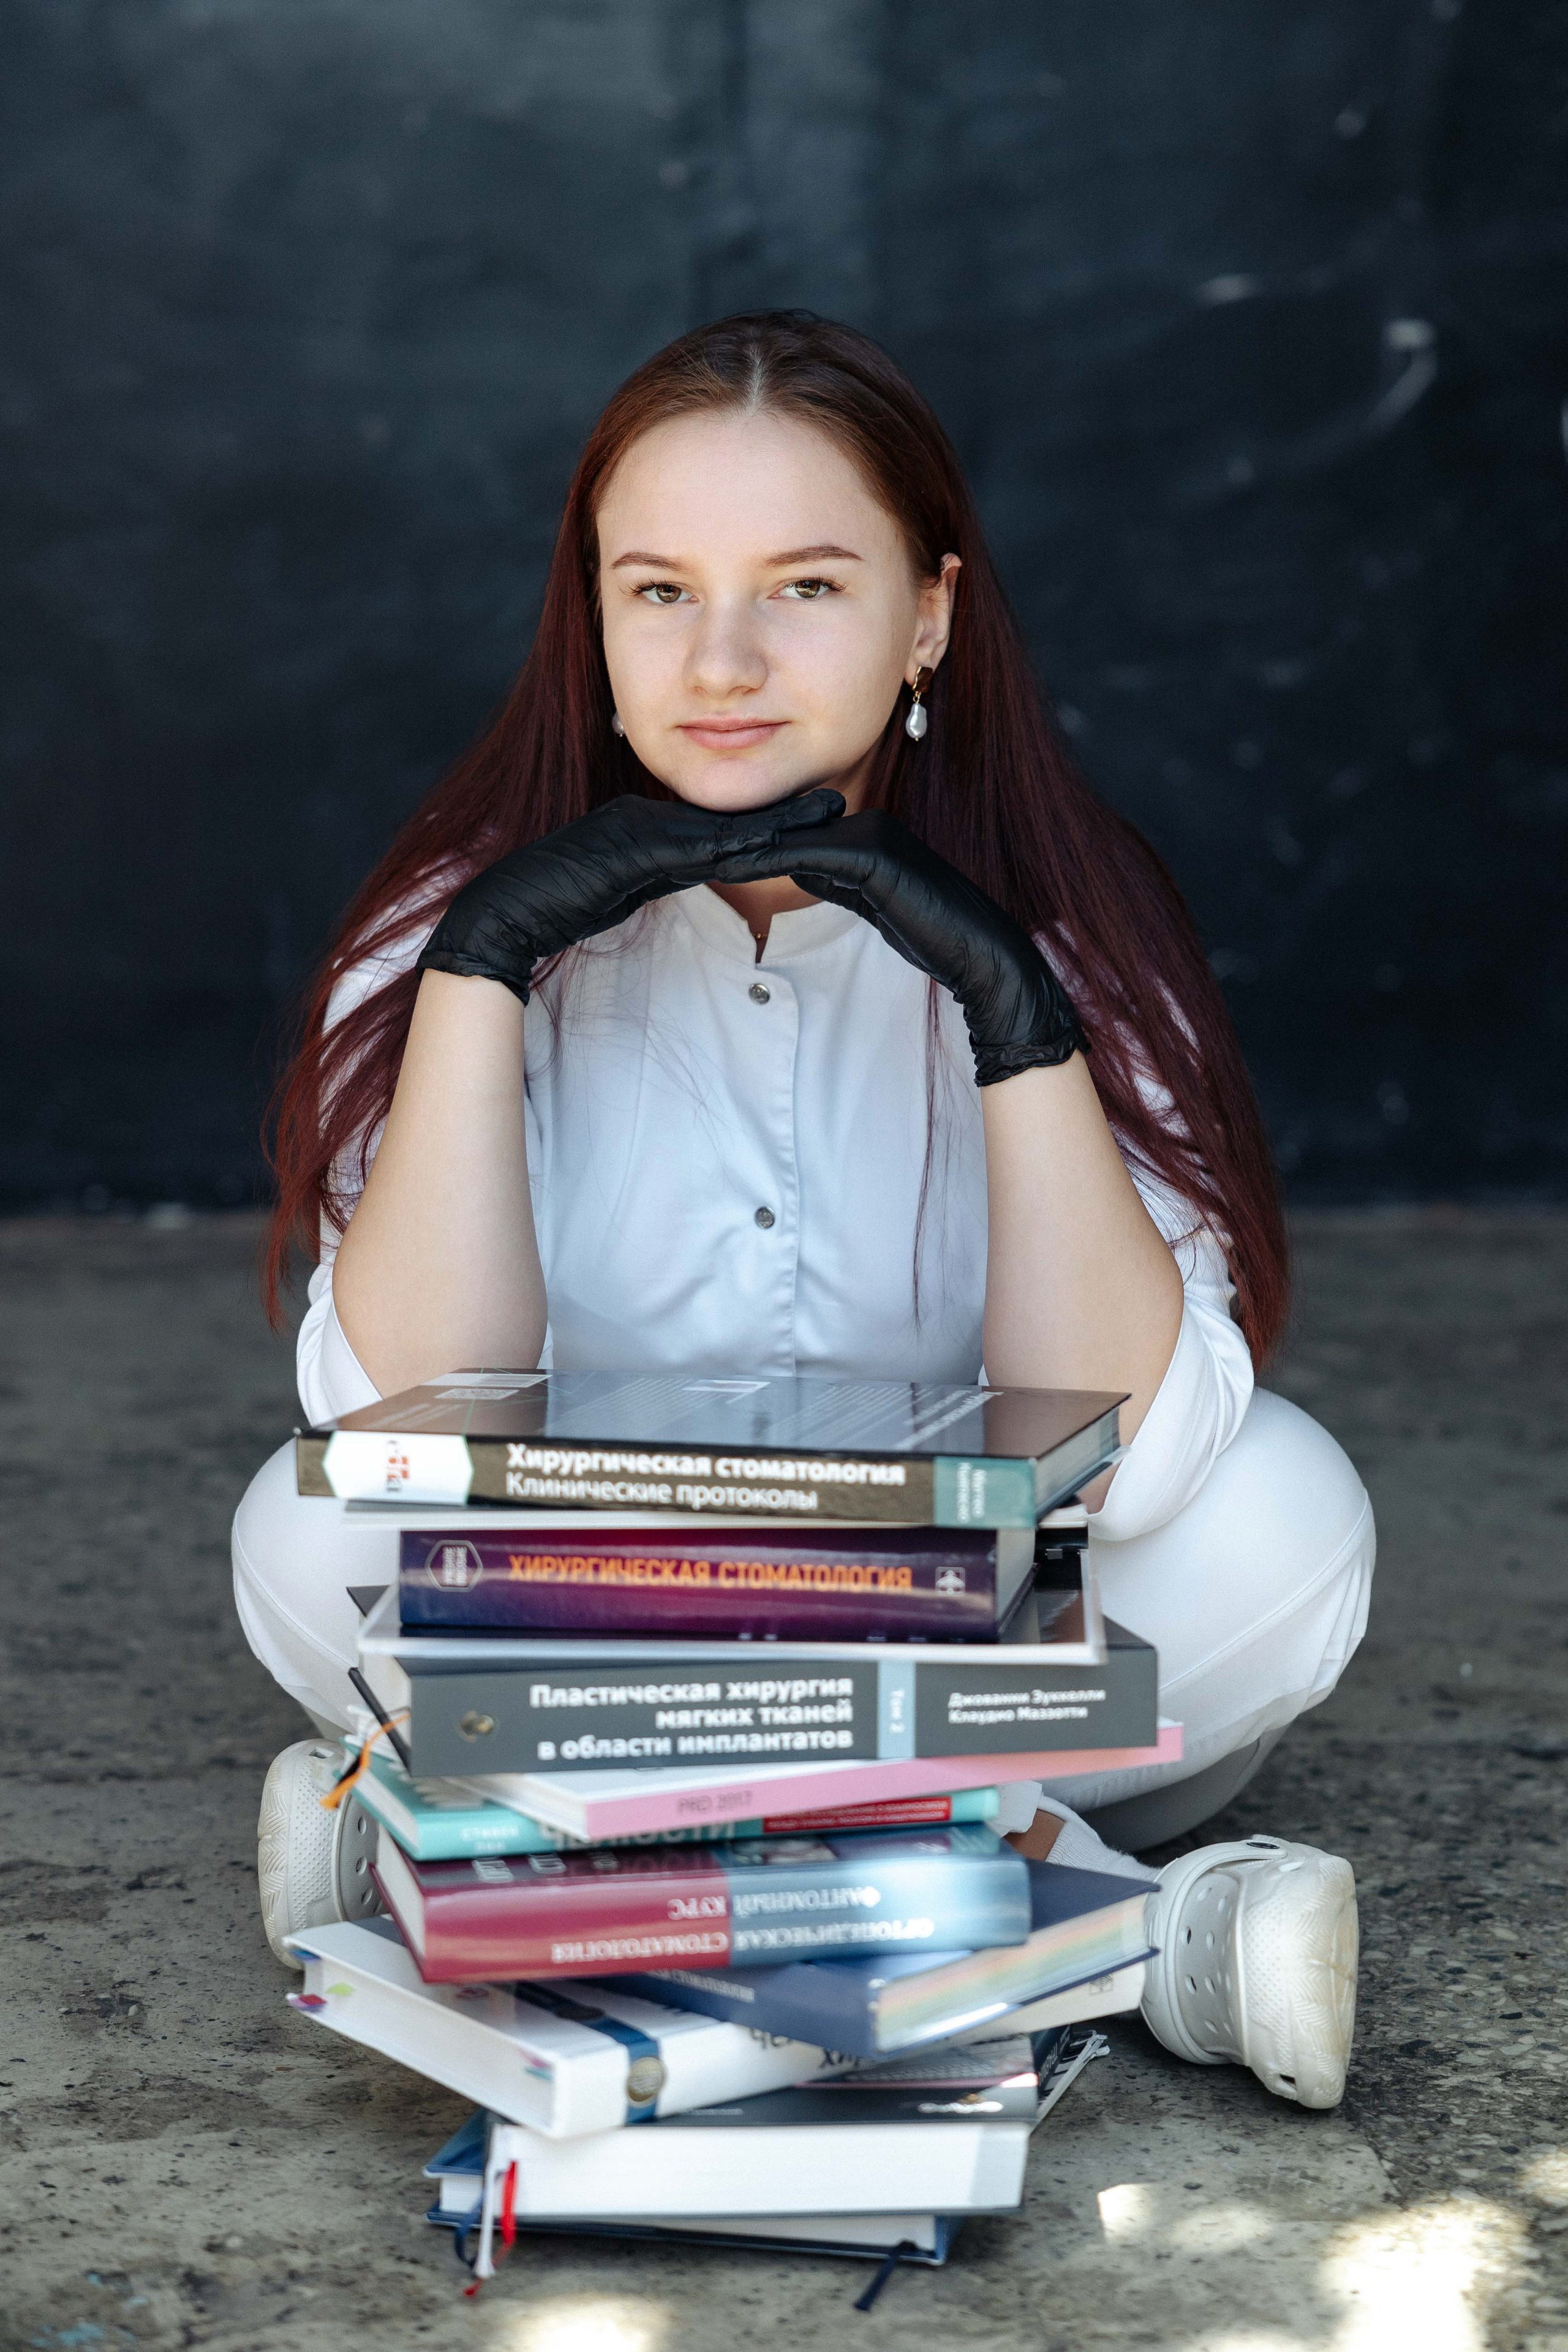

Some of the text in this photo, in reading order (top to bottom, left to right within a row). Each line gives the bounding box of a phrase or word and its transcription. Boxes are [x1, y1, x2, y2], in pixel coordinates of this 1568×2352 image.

[507, 1442, 907, 1485] Хирургическая стоматология
[505, 1471, 818, 1510] Клинические протоколы
[508, 1554, 913, 1591] ХИРУРГИЧЕСКАЯ СТОМАТОЛОГИЯ
[530, 1678, 853, 1708] Пластическая хирургия
[655, 1700, 853, 1730] мягких тканей
[537, 1731, 853, 1760] в области имплантатов
[666, 1886, 882, 1921] ФАНТОМНЫЙ КУРС
[550, 1917, 935, 1964] ОРТОПЕДИЧЕСКАЯ СТОМАТОЛОГИЯ
